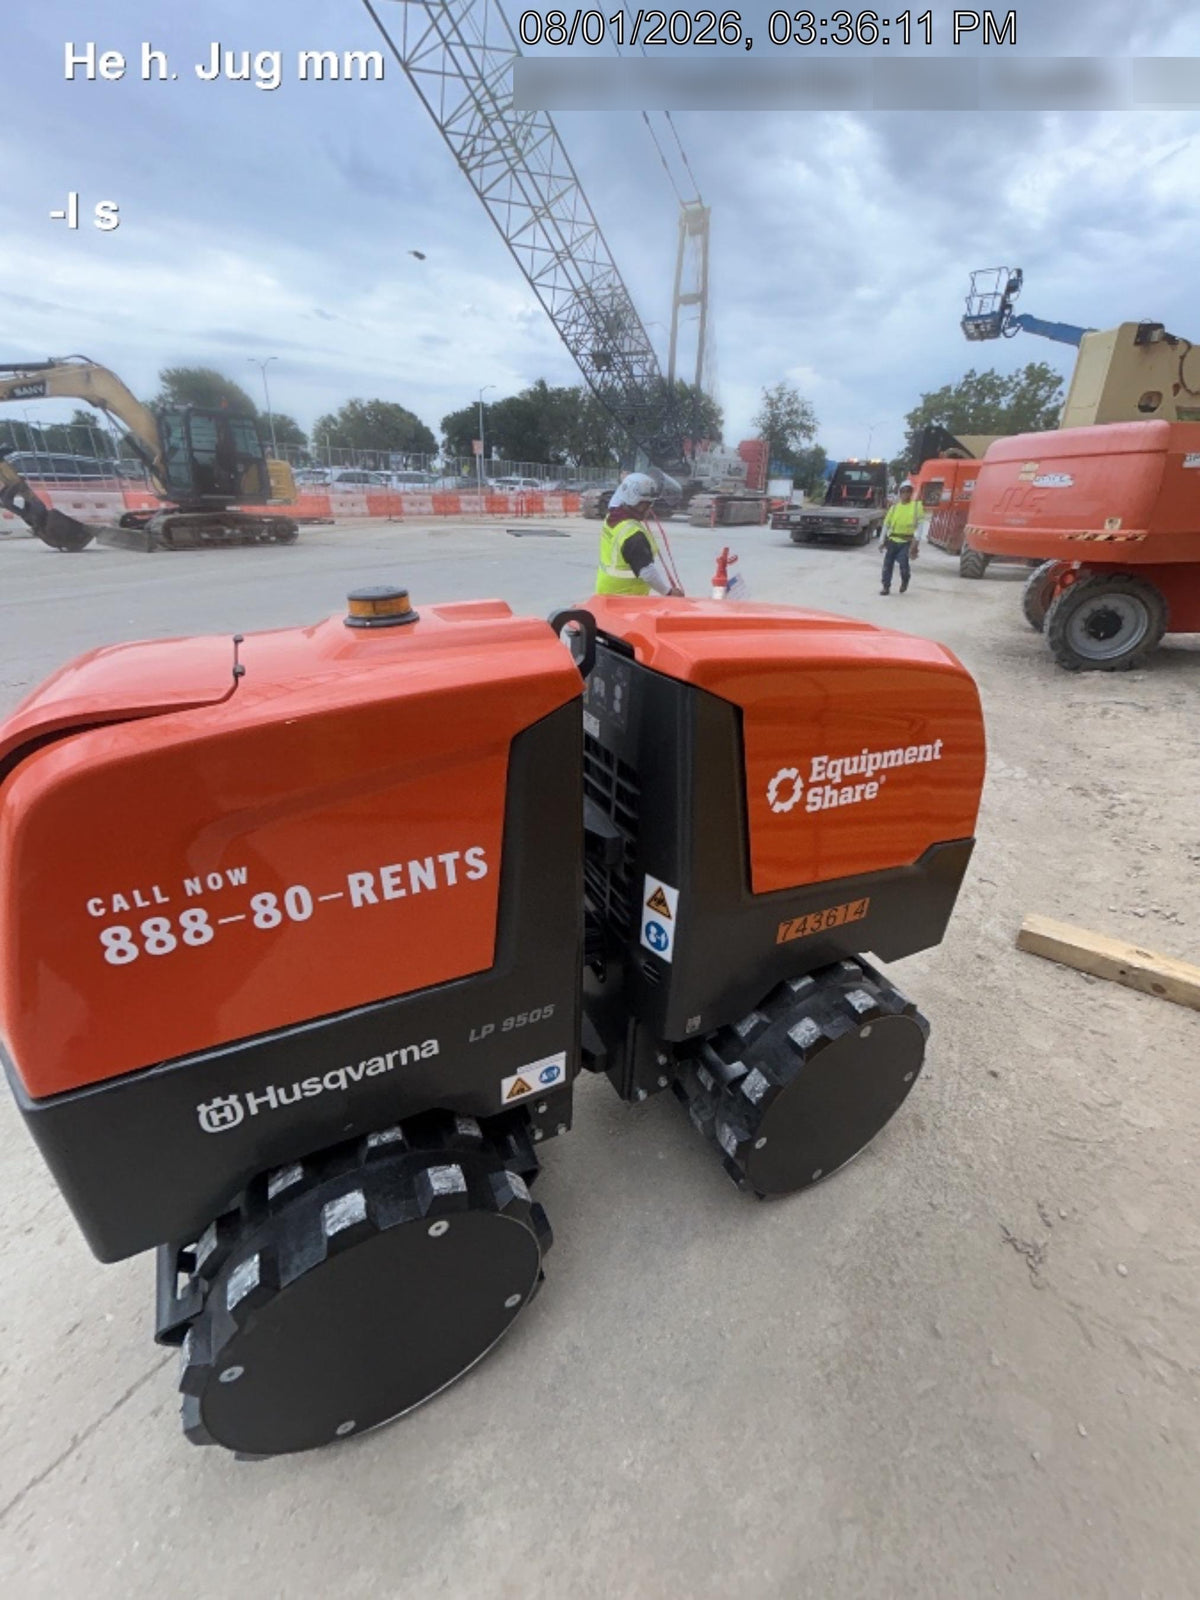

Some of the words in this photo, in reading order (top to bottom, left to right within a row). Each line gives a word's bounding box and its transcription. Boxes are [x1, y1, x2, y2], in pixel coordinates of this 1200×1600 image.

[808, 738, 943, 784] Equipment
[805, 780, 880, 813] Share
[86, 885, 170, 918] CALL
[183, 866, 248, 896] NOW
[99, 846, 489, 966] 888-80-RENTS
[781, 899, 867, 942] 743614
[469, 1023, 495, 1042] LP
[501, 1003, 556, 1032] 9505
[245, 1038, 440, 1116] Husqvarna
